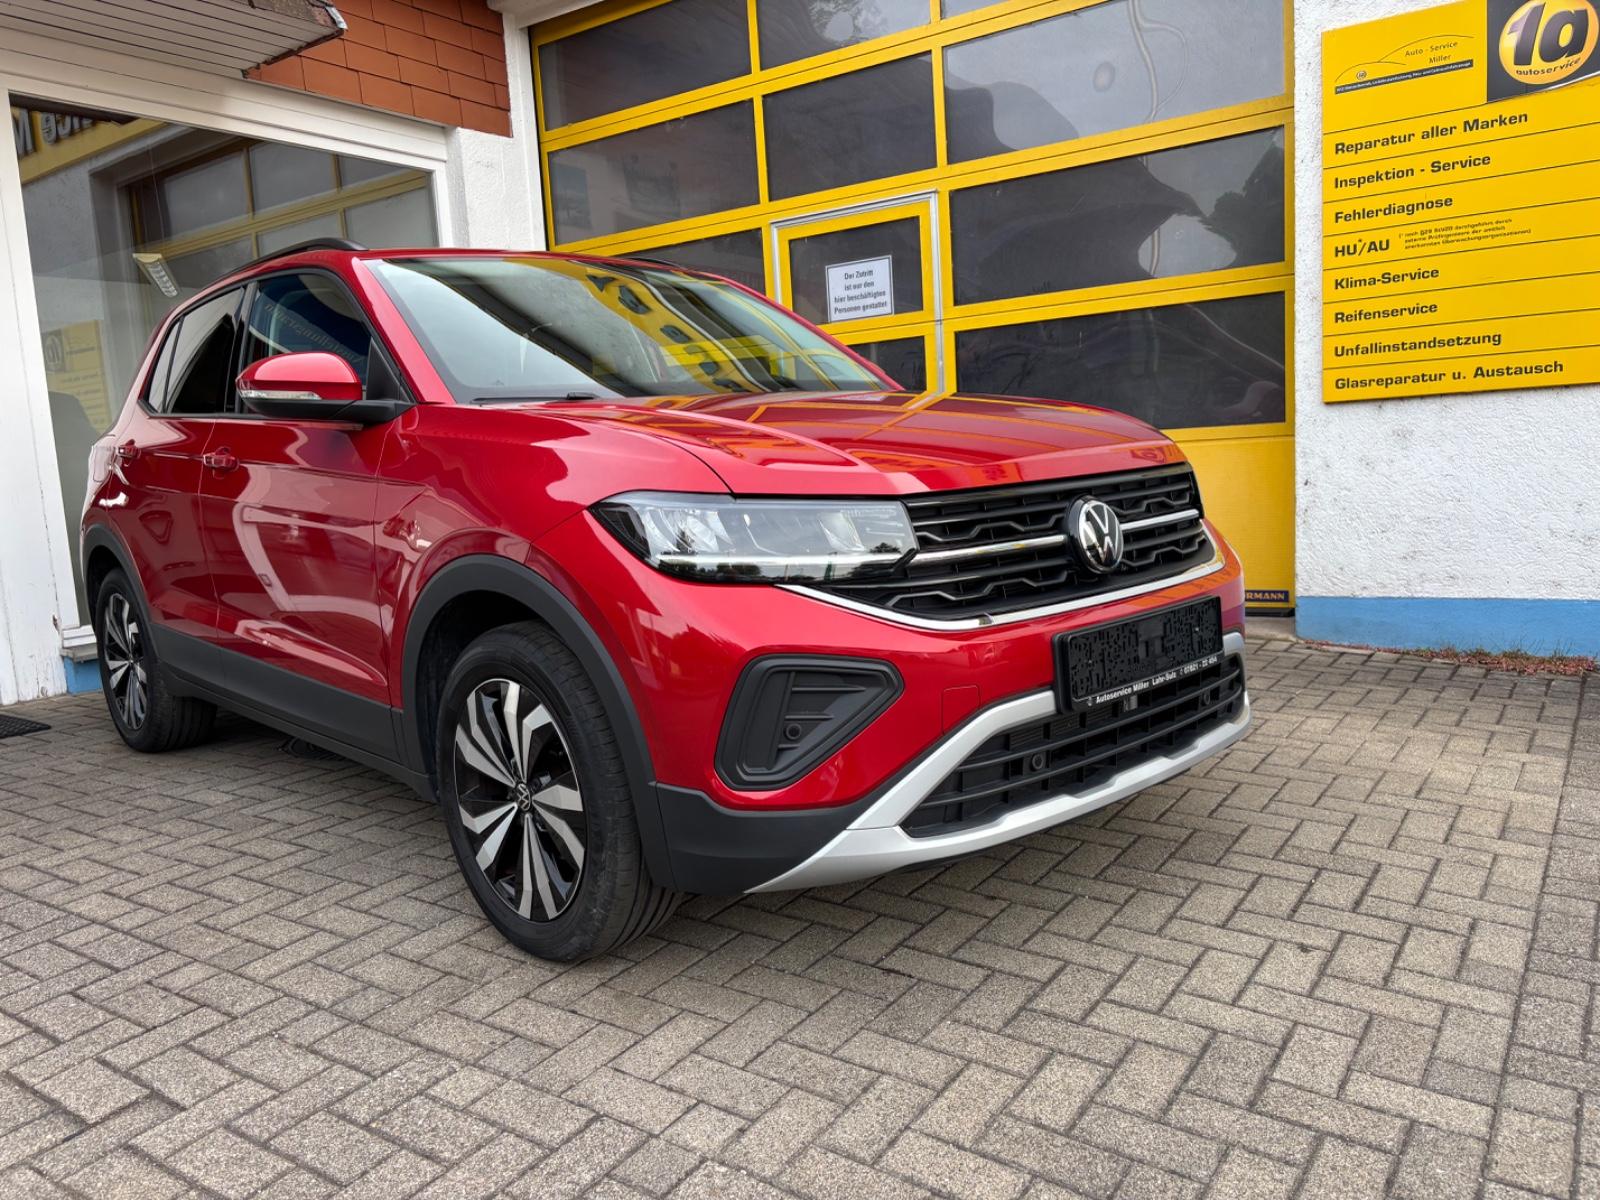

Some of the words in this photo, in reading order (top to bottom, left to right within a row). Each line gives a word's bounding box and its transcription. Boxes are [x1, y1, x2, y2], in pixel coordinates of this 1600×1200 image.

[1507, 1, 1589, 66] 1a
[1405, 48, 1424, 57] Auto
[1430, 41, 1458, 52] Service
[1429, 54, 1452, 64] Miller
[1516, 57, 1581, 76] autoservice
[1334, 133, 1416, 155] Reparatur
[1421, 125, 1457, 140] aller
[1463, 113, 1528, 133] Marken
[1334, 168, 1415, 189] Inspektion
[1430, 155, 1491, 173] Service
[1334, 197, 1453, 224] Fehlerdiagnose
[855, 270, 874, 278] Zutritt
[1334, 268, 1439, 290] Klima-Service
[834, 305, 861, 315] Personen
[1334, 303, 1438, 324] Reifenservice
[1334, 333, 1502, 358] Unfallinstandsetzung
[1334, 371, 1446, 390] Glasreparatur
[1452, 371, 1466, 380] u.
[1473, 361, 1564, 379] Austausch
[1246, 592, 1285, 600] RMANN
[1096, 687, 1132, 704] Autoservice
